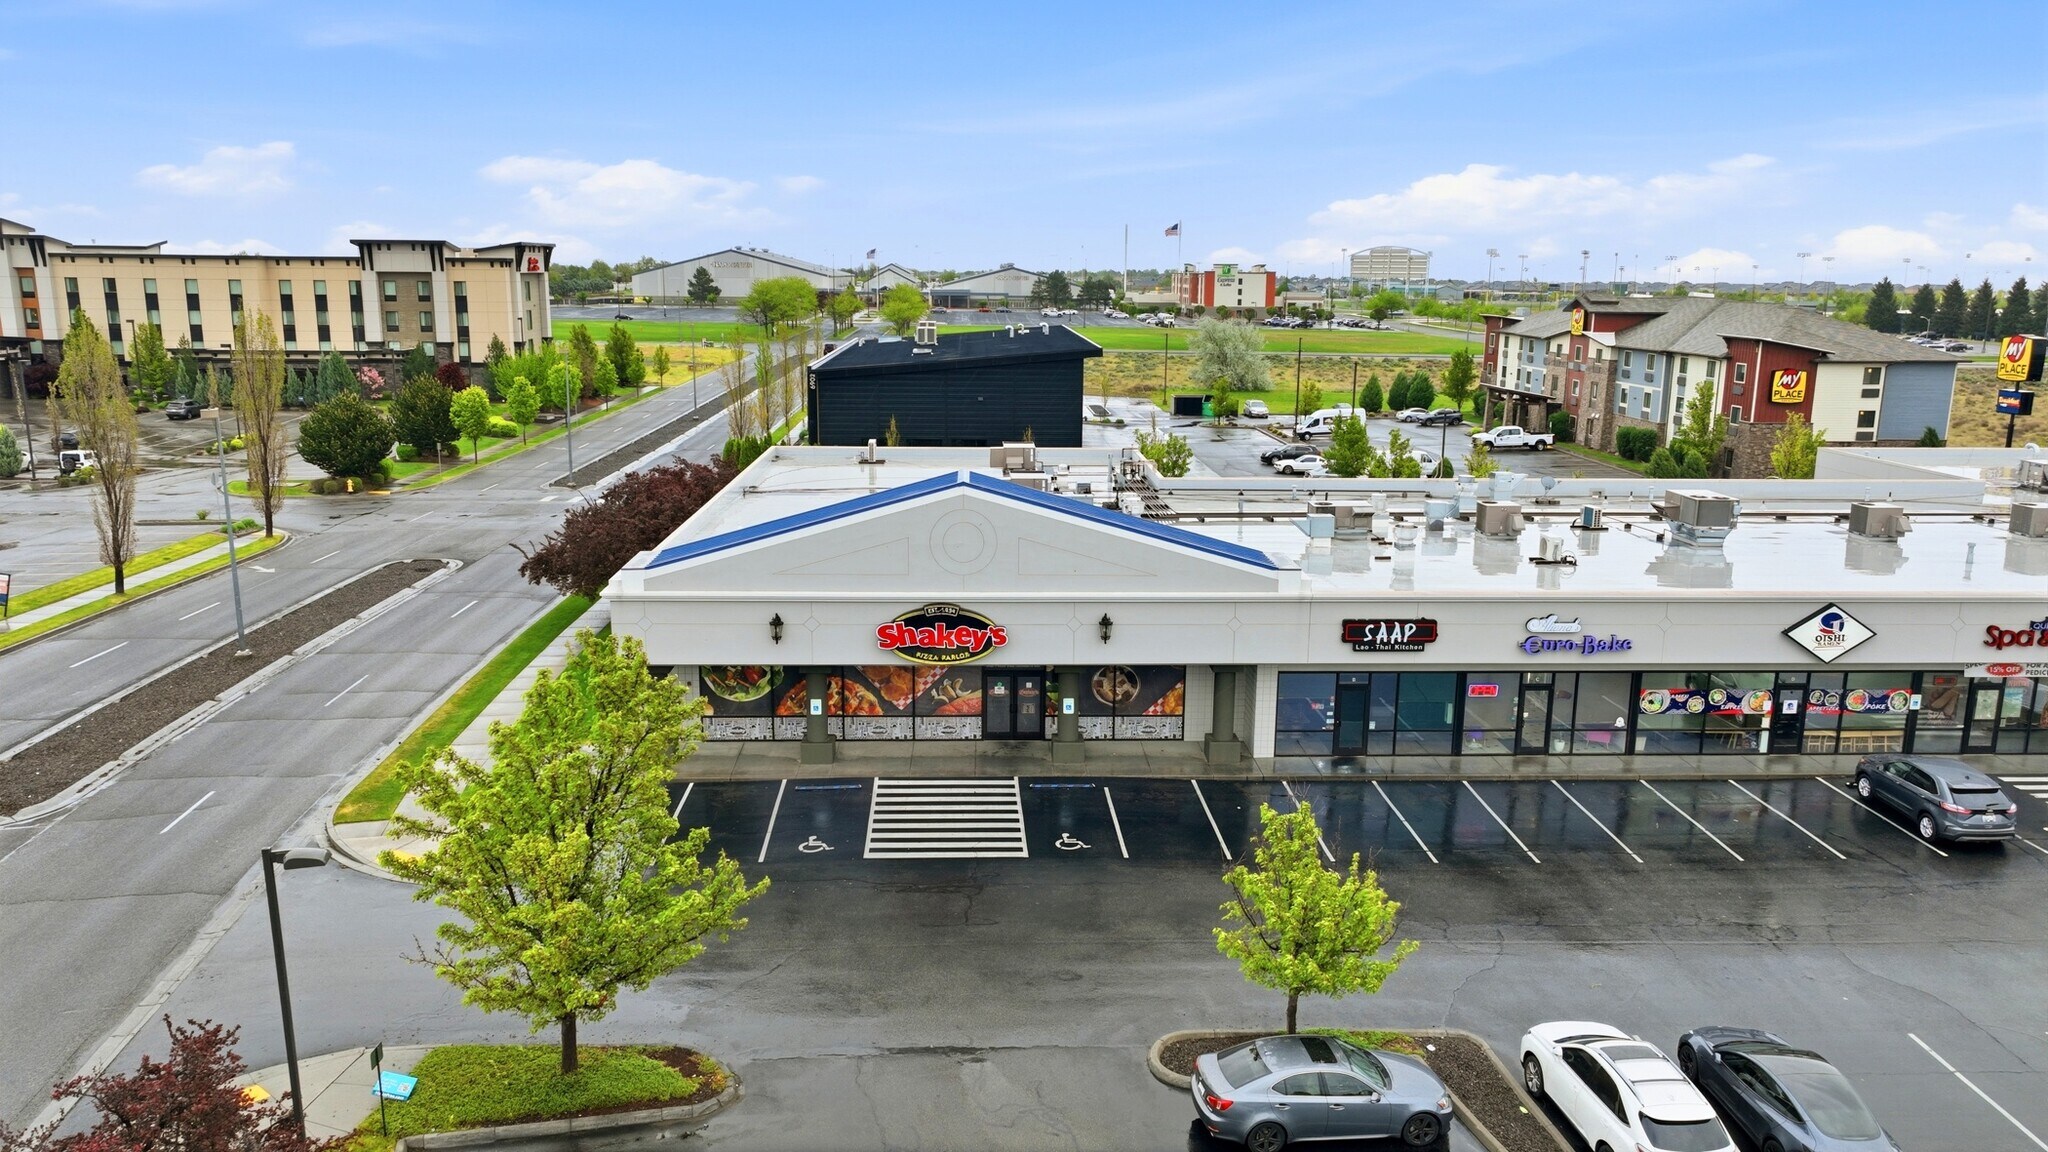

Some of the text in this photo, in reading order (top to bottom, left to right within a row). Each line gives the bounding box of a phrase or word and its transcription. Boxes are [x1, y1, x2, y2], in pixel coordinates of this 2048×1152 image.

[2004, 338, 2027, 360] MY
[2000, 363, 2027, 374] PLACE
[1777, 370, 1802, 388] MY
[1773, 390, 1803, 398] PLACE
[876, 621, 1008, 652] Shakey's
[1363, 621, 1417, 644] SAAP
[1815, 634, 1846, 642] OISHI
[1983, 625, 2035, 650] Spa
[915, 652, 971, 661] PIZZA PARLOR
[1989, 665, 2005, 674] 15%
